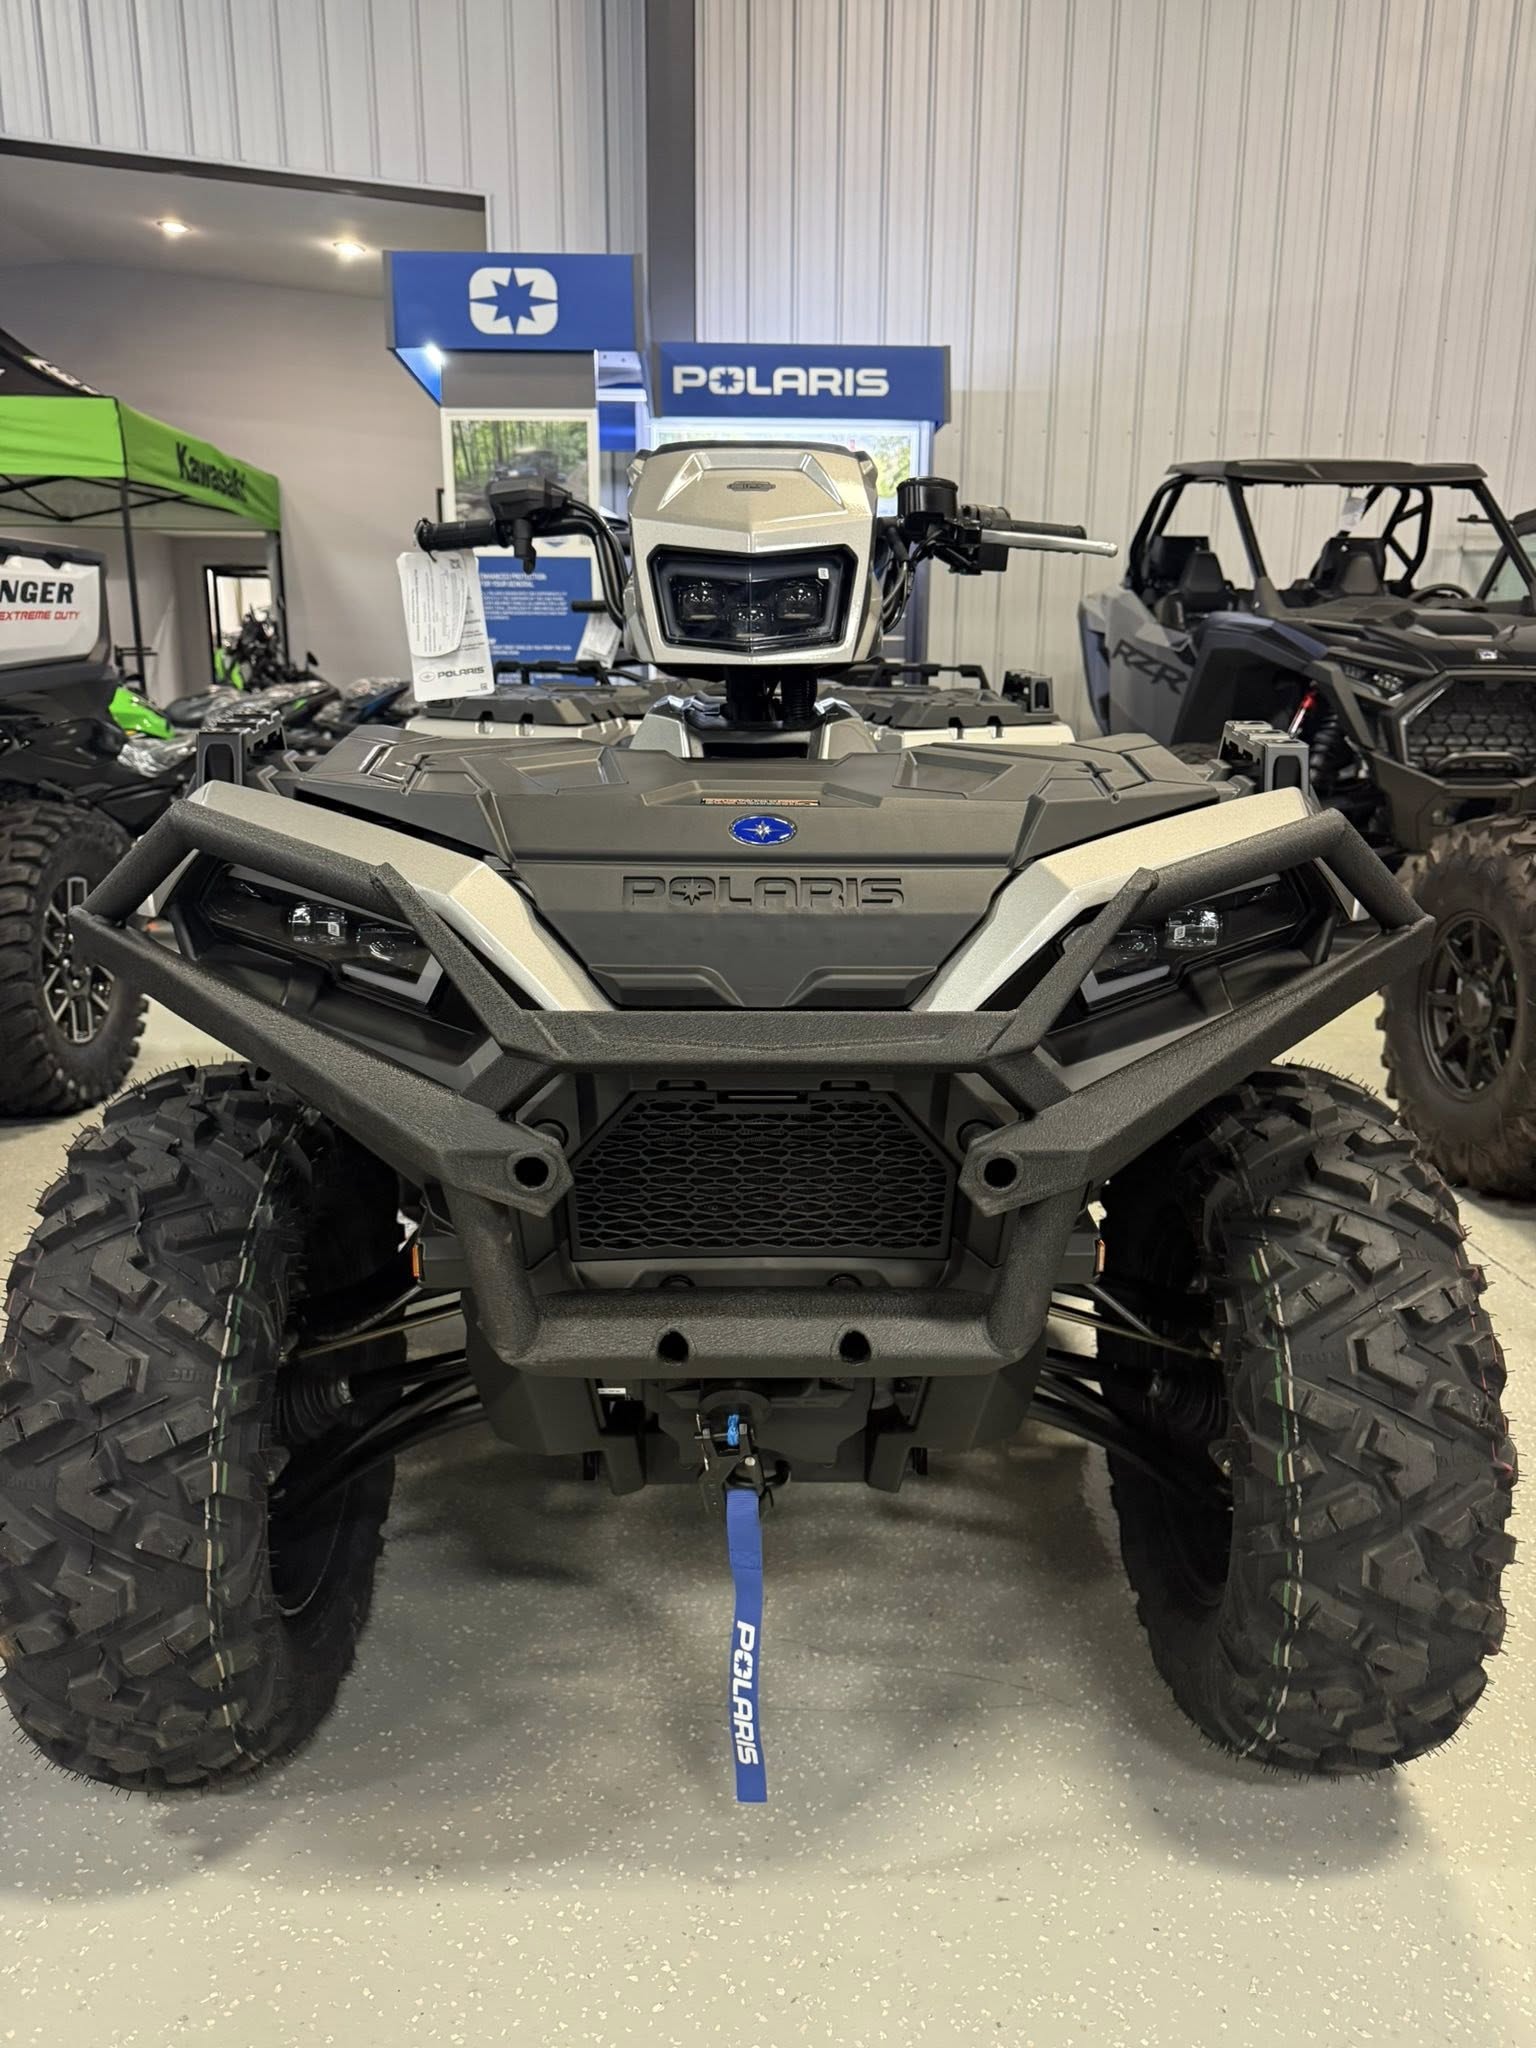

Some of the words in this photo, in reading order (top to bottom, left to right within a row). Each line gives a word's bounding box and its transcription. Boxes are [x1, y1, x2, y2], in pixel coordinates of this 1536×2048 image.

[673, 365, 889, 397] POLARIS
[176, 441, 247, 502] Kawasaki
[54, 611, 80, 620] DUTY
[437, 666, 485, 680] POLARIS
[1112, 638, 1188, 695] RZR
[622, 875, 905, 909] POLARIS
[733, 1620, 759, 1766] POLARIS
